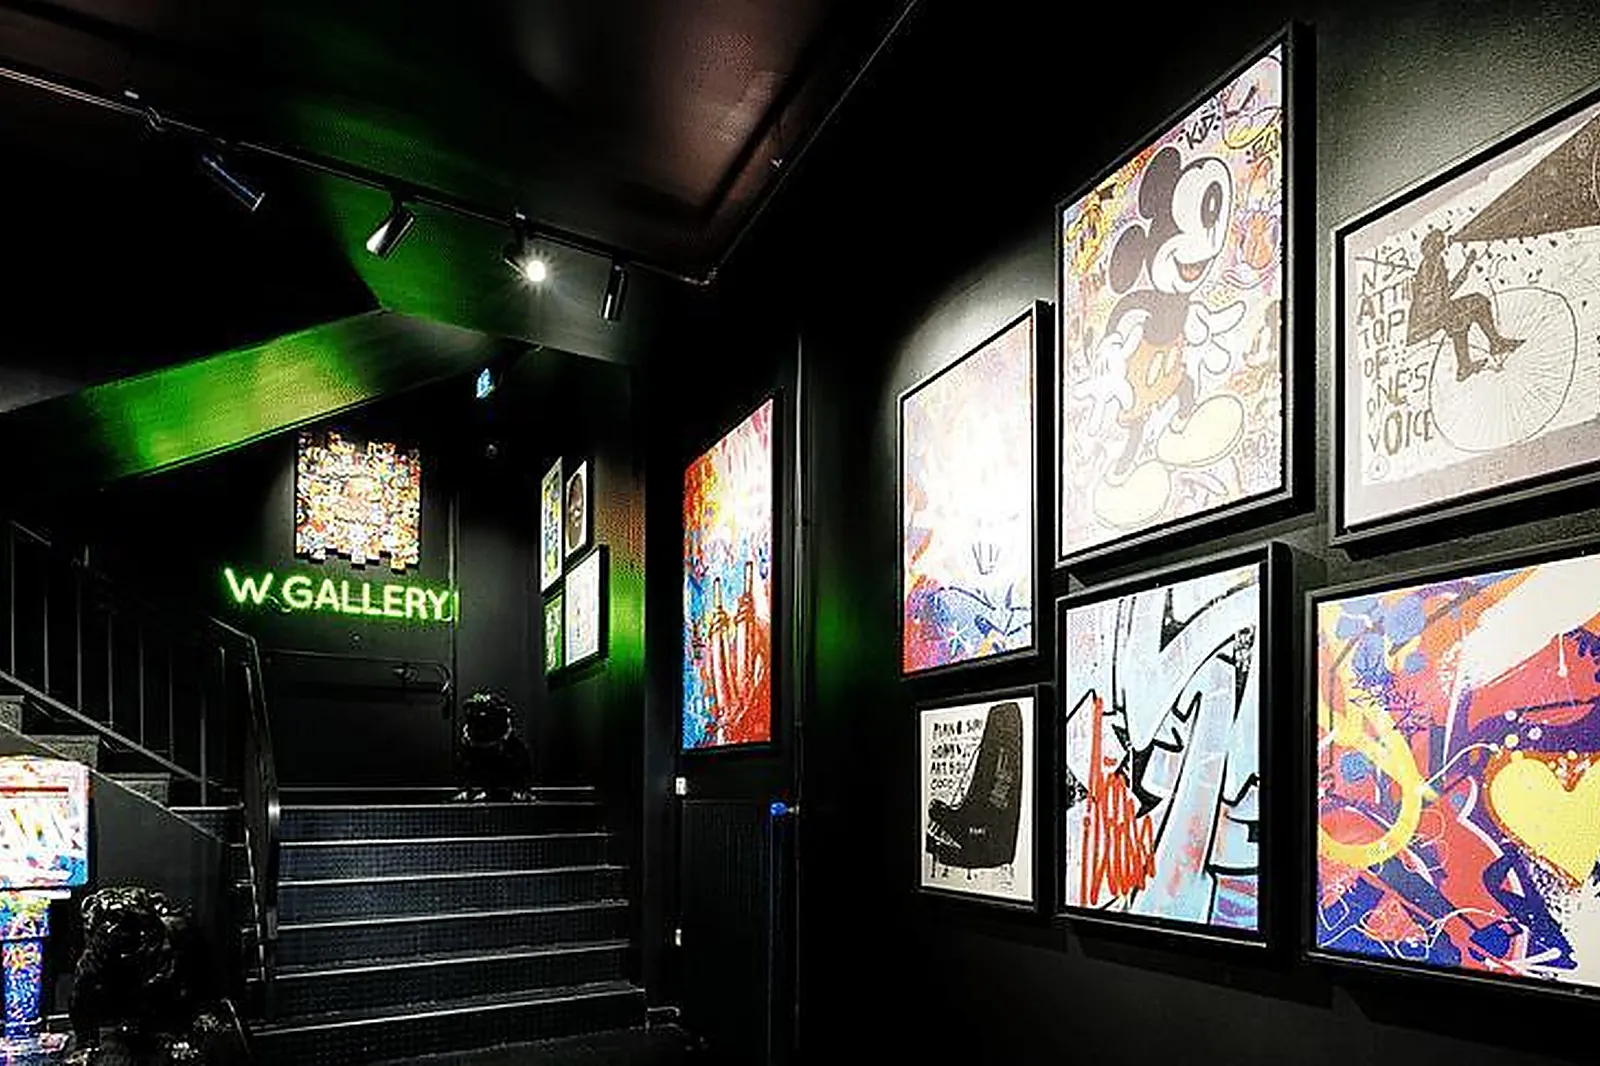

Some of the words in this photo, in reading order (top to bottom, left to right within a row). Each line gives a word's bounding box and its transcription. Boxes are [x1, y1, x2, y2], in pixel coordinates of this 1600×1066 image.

[1357, 309, 1405, 349] TOP
[1364, 345, 1389, 379] OF
[1367, 408, 1435, 456] VOICE
[223, 567, 274, 605] W
[281, 575, 450, 621] GALLERY
